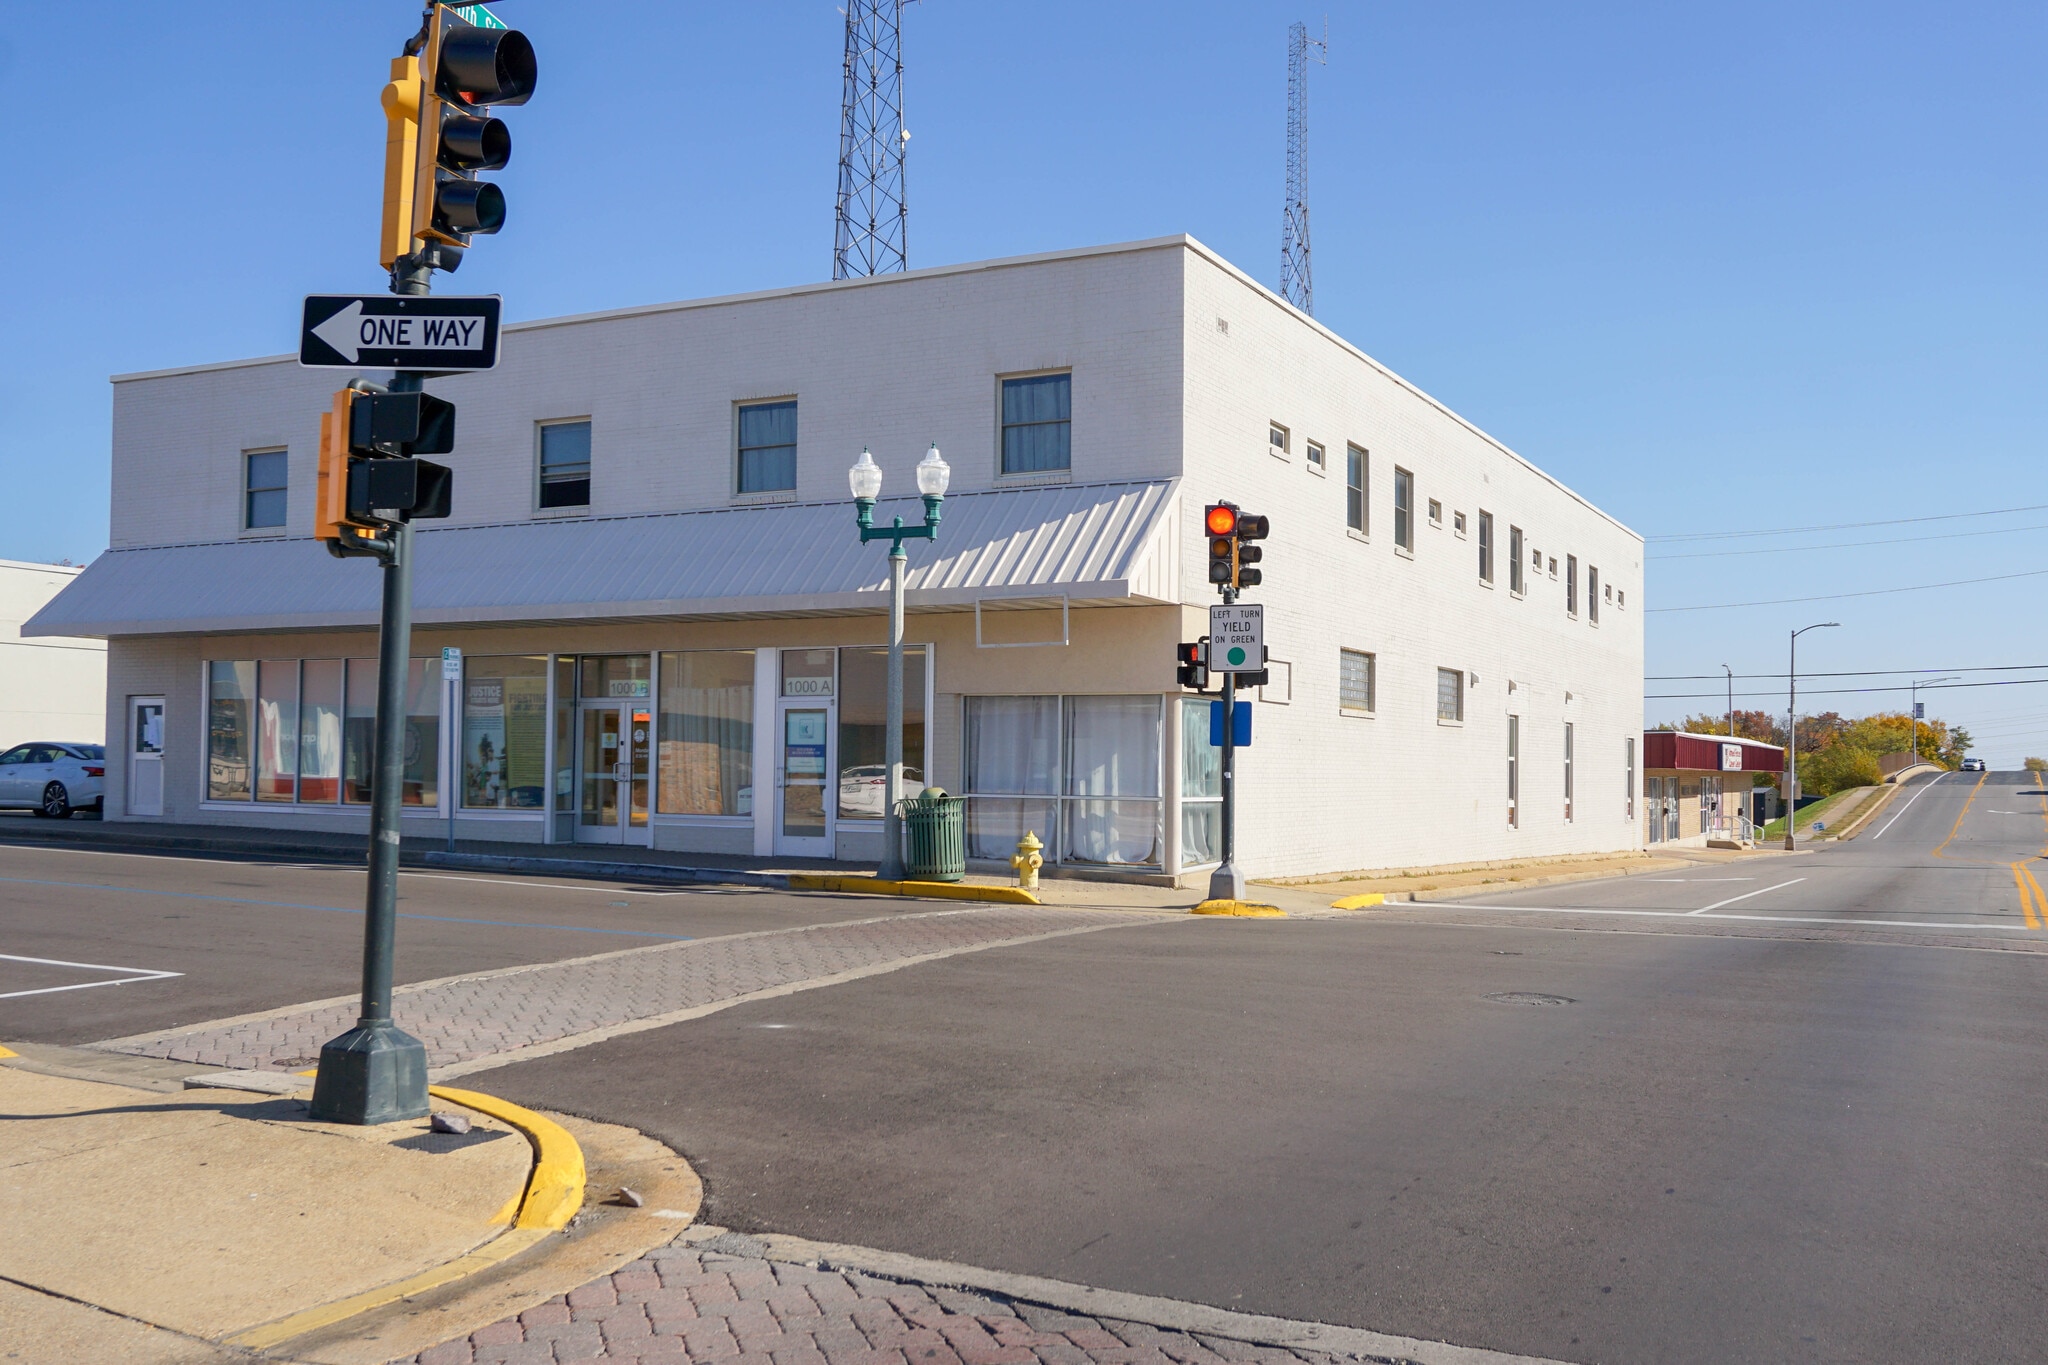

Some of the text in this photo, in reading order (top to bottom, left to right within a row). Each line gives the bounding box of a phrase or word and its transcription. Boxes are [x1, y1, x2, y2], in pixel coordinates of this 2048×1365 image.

[360, 318, 478, 347] ONE WAY
[1213, 610, 1260, 619] LEFT TURN
[1222, 621, 1251, 632] YIELD
[1215, 634, 1256, 644] ON GREEN
[470, 685, 502, 697] JUSTICE
[610, 682, 649, 695] 1000 B
[787, 680, 831, 693] 1000 A
